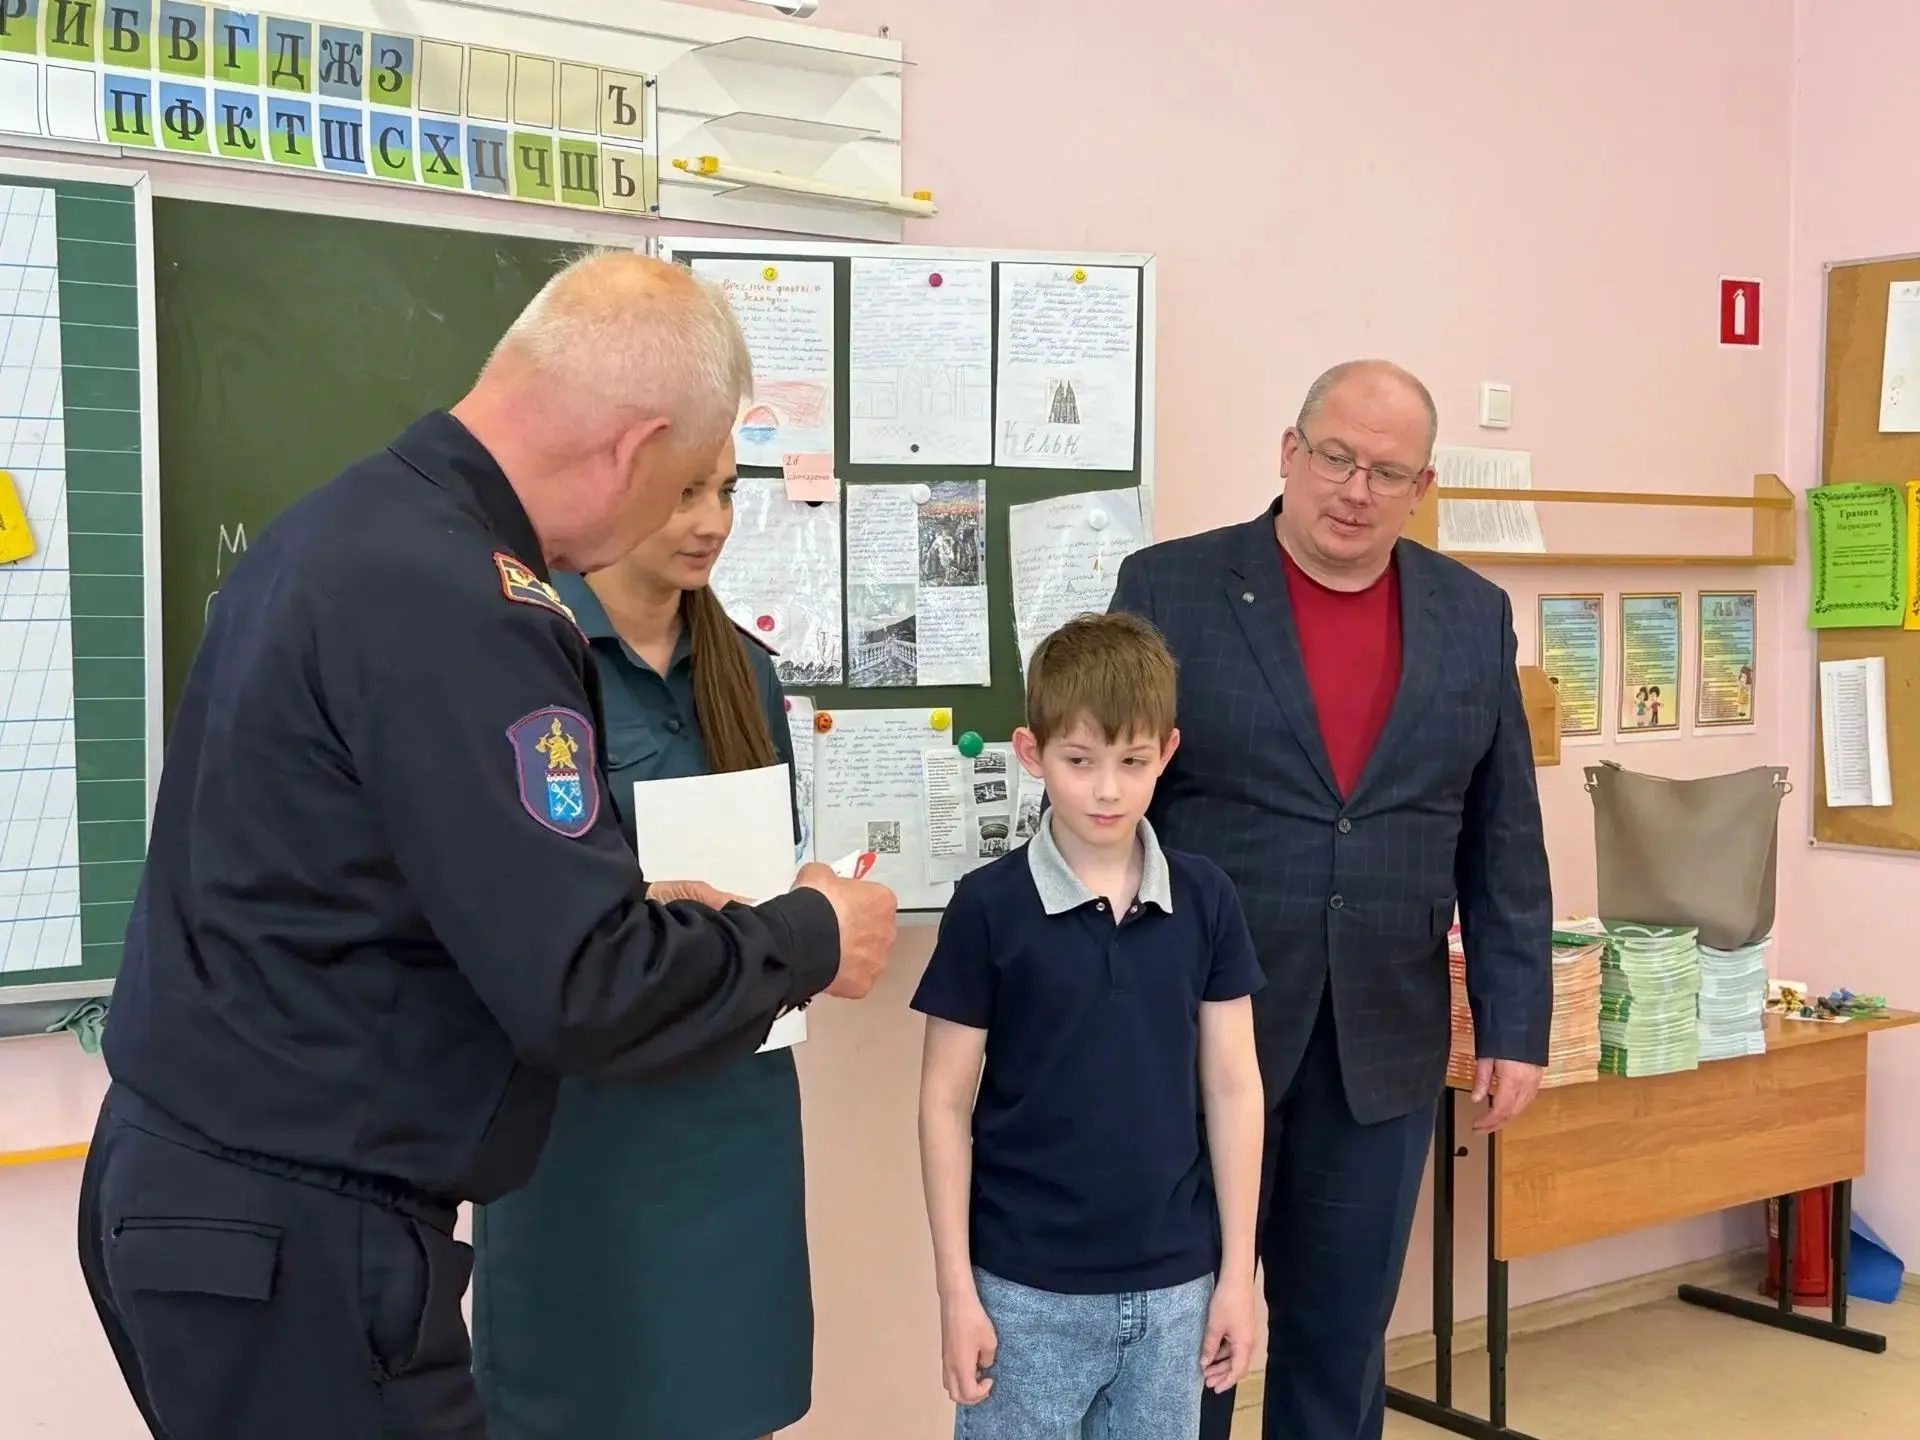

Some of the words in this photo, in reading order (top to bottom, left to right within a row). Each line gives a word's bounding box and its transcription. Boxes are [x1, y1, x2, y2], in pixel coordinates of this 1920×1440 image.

[52, 0, 91, 47] И
[109, 7, 140, 53] Б
[168, 16, 199, 61] В
[224, 24, 250, 69] Г
[272, 32, 305, 90] Д
[319, 39, 363, 87] Ж
[378, 48, 403, 92] З
[608, 85, 637, 126] Ъ
[110, 89, 149, 136] П
[165, 98, 204, 141] Ф
[222, 104, 255, 150] К
[276, 112, 305, 155] Т
[320, 118, 365, 163] Ш
[379, 126, 406, 169] С
[424, 132, 459, 176] Х
[472, 138, 507, 190] Ц
[519, 146, 551, 187] Ч
[560, 150, 600, 199] Щ
[611, 157, 636, 197] Ь
[1839, 509, 1878, 520] Грамота
